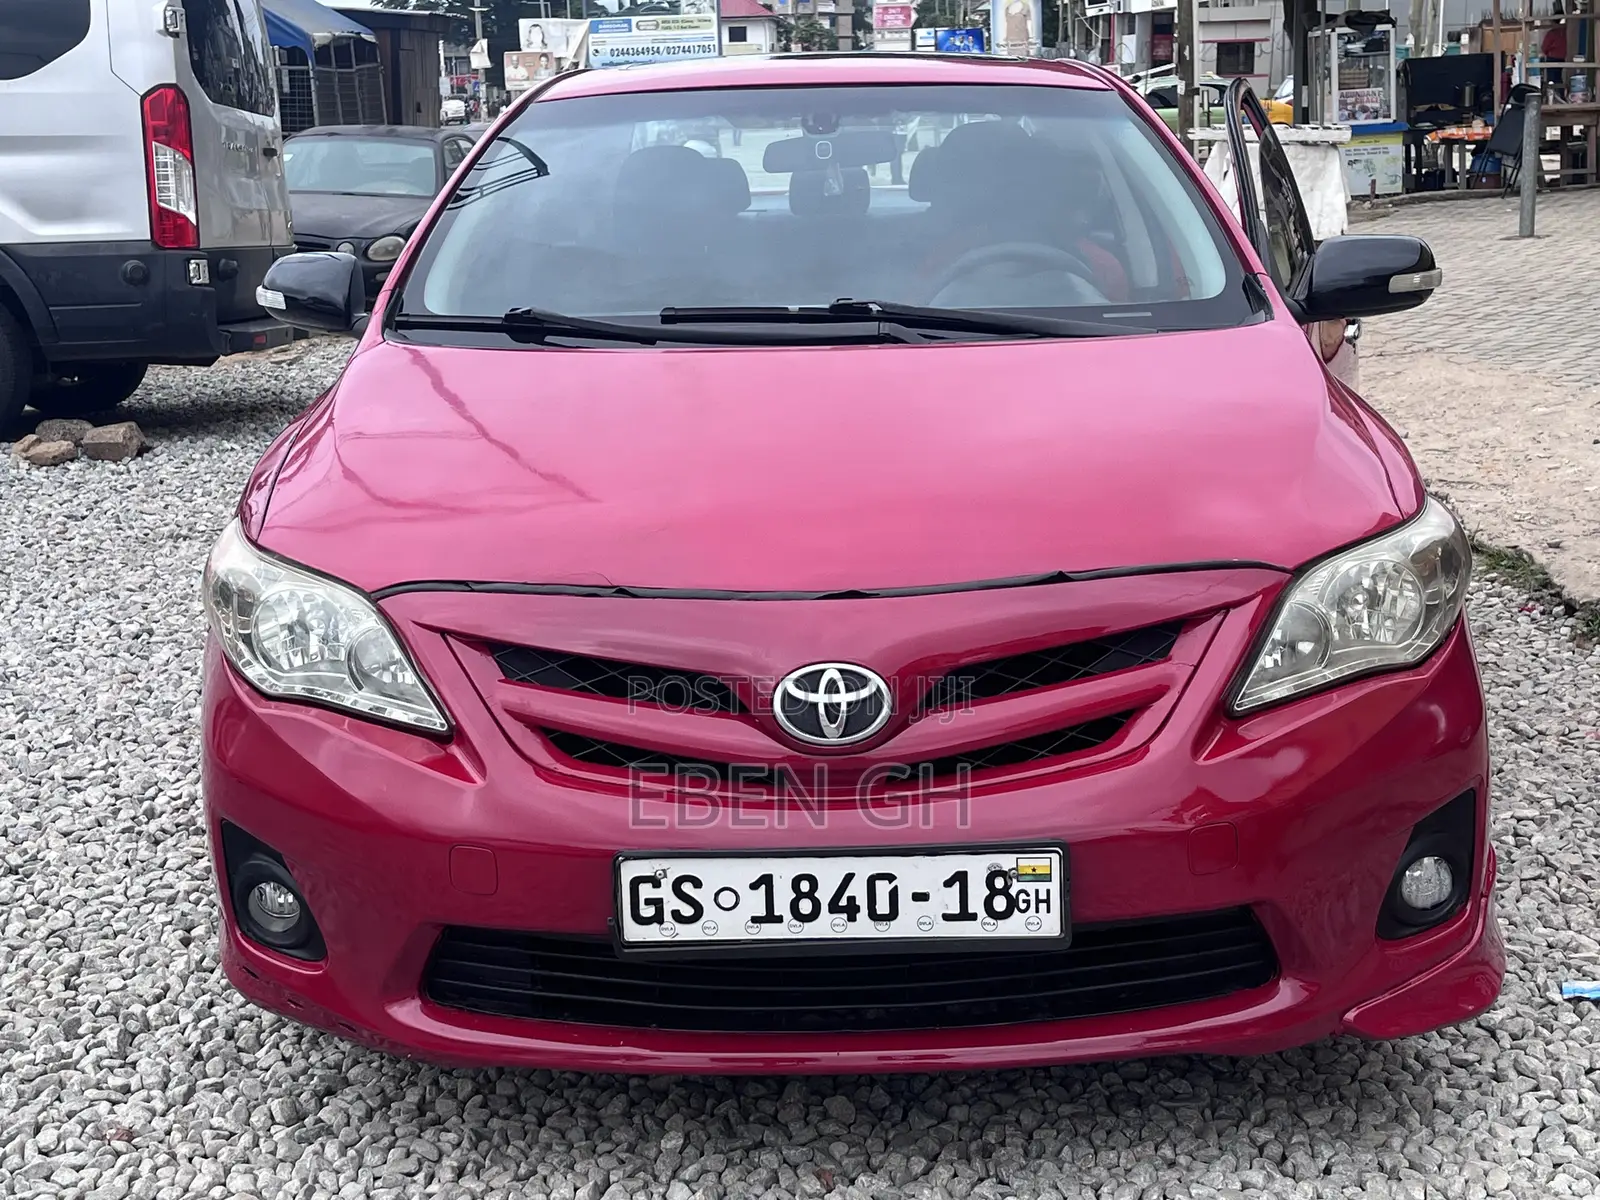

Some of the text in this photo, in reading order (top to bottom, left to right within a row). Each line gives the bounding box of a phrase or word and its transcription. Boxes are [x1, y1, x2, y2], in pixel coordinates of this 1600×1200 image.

[609, 44, 716, 57] 0244364954/0274417051
[629, 873, 704, 926] GS
[1015, 888, 1051, 914] GH
